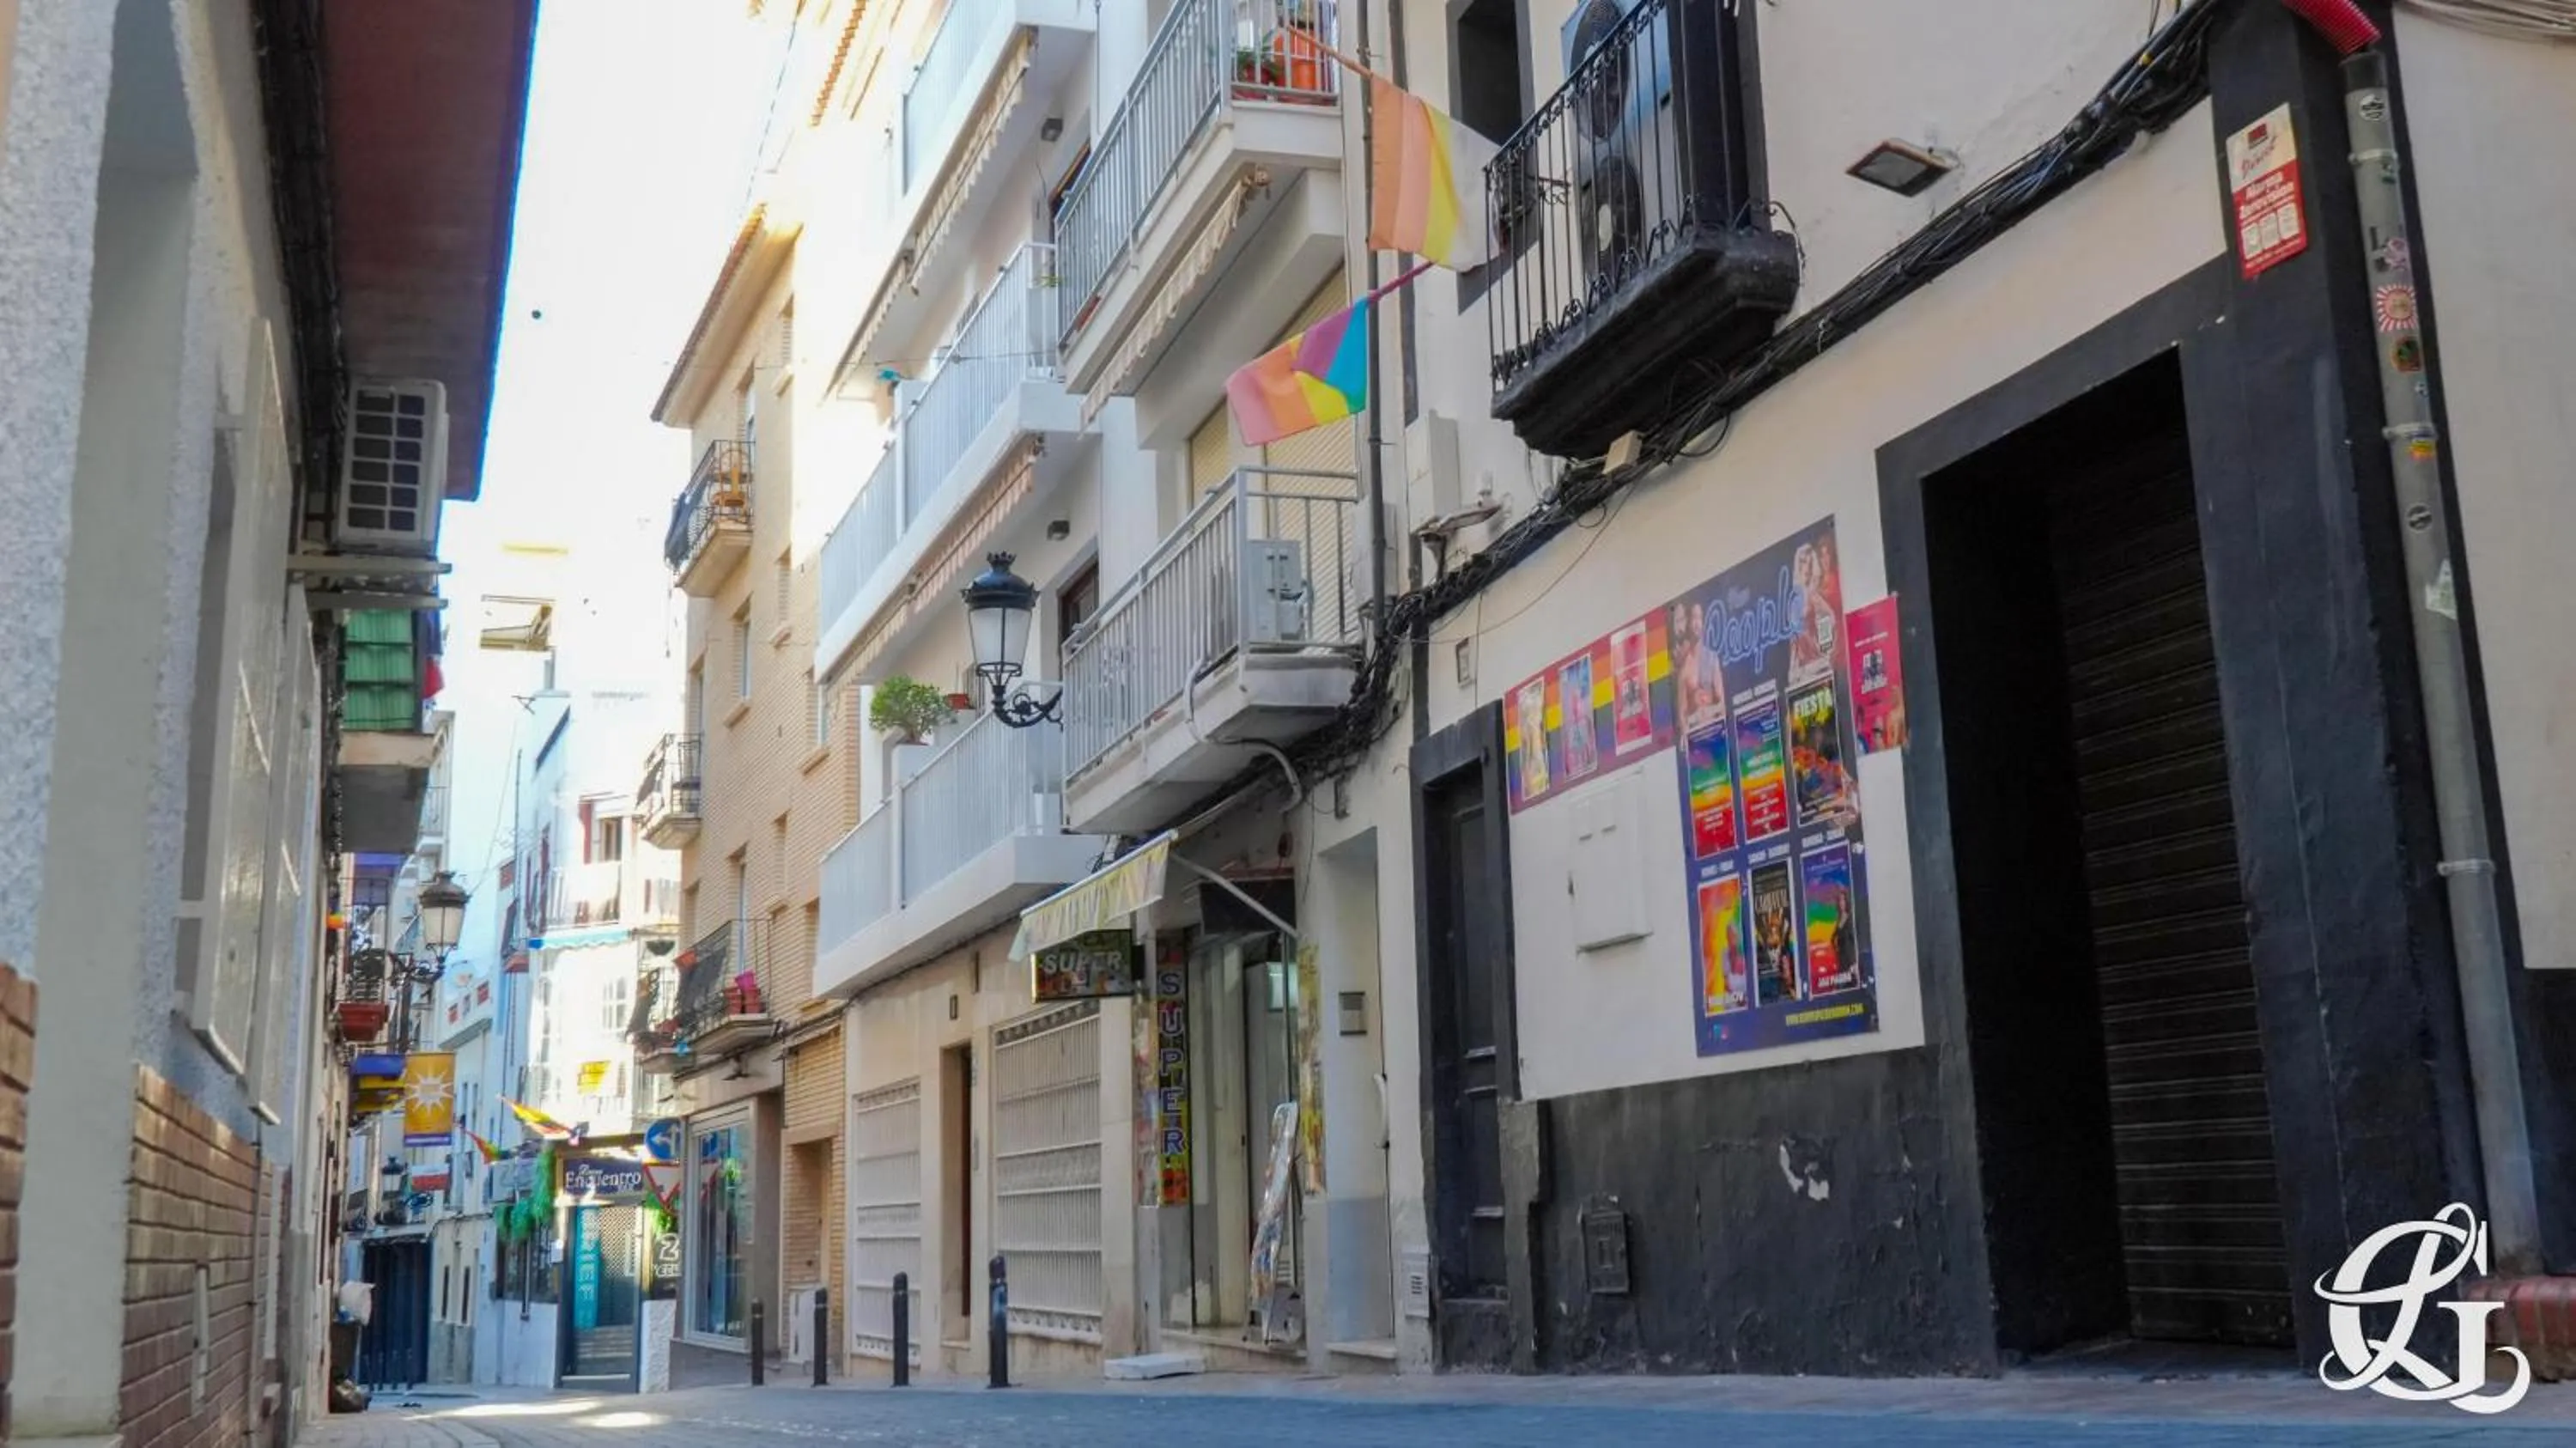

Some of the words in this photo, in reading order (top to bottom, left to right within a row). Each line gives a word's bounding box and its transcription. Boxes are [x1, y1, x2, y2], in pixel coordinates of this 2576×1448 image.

[1704, 565, 1808, 674] People
[1793, 687, 1834, 719] FIESTA
[1044, 952, 1122, 976] SUPER
[1159, 971, 1184, 1155] SUPER
